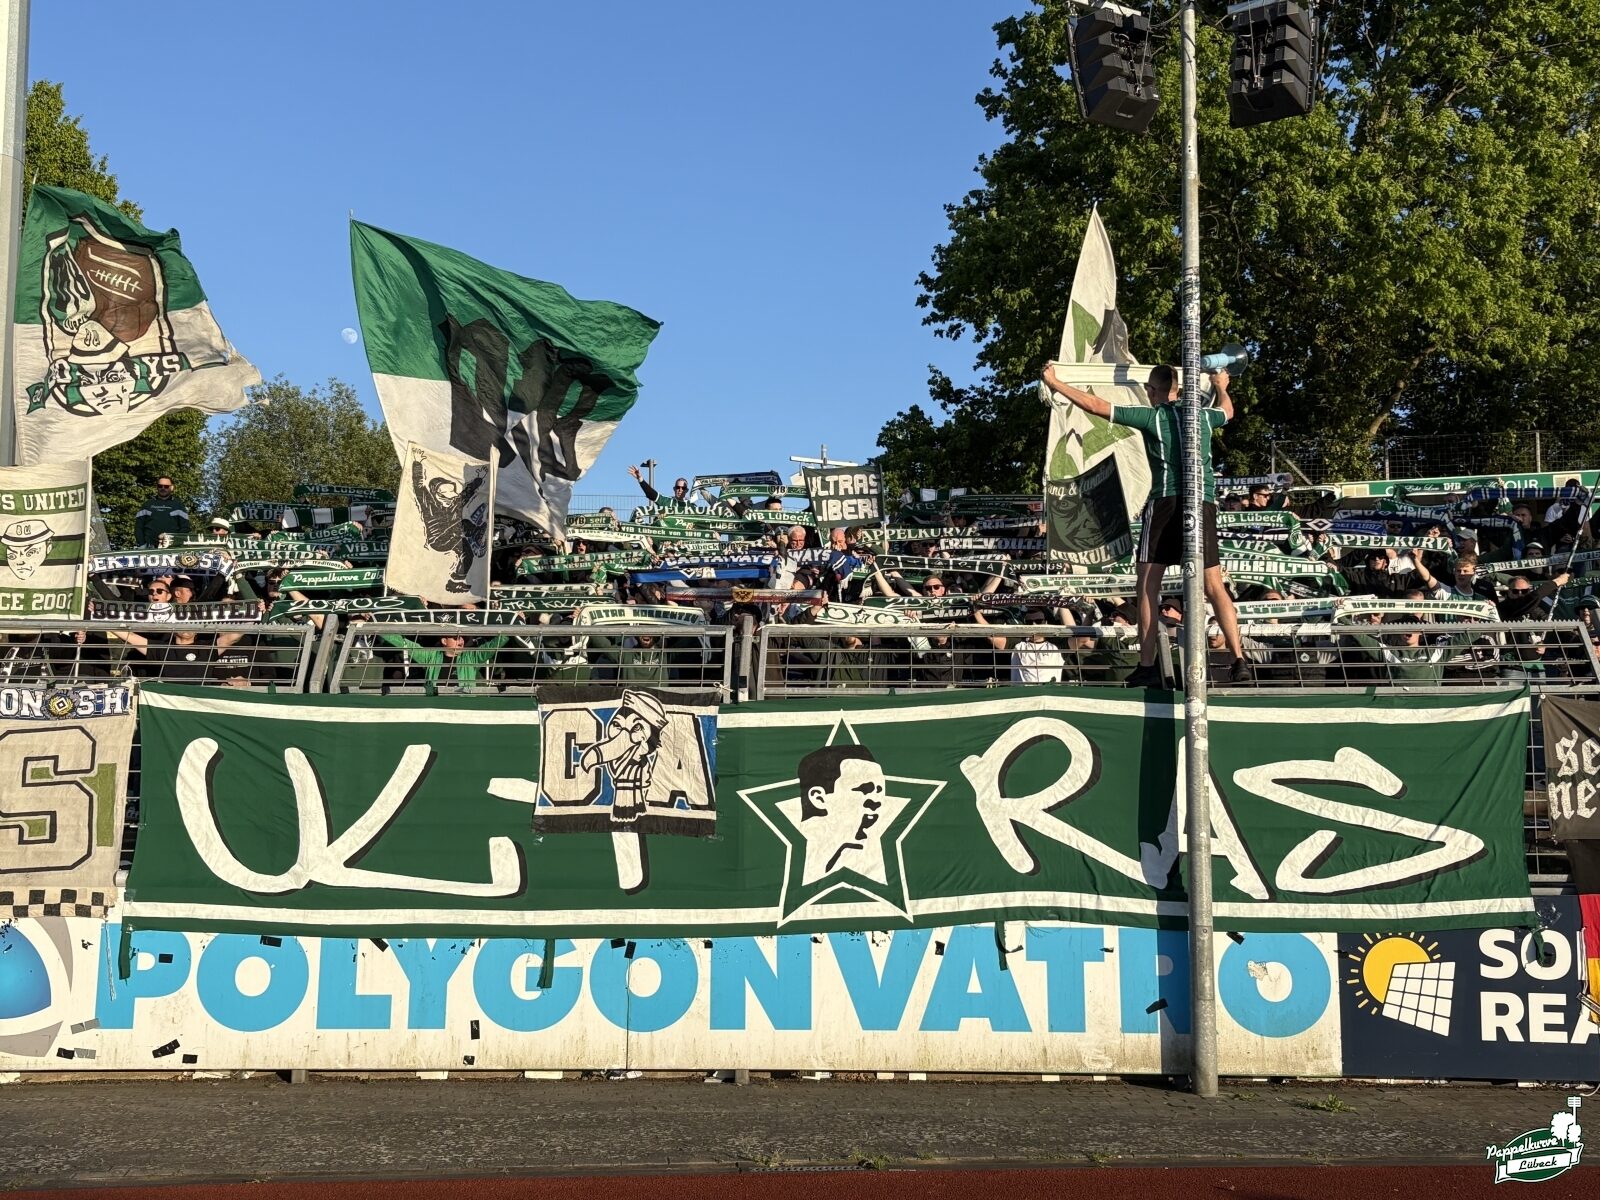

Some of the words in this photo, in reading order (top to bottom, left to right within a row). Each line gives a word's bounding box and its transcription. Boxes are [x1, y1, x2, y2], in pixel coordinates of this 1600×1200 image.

[807, 474, 879, 497] ULTRAS
[1233, 476, 1274, 485] VEREIN
[307, 485, 329, 493] VfB
[334, 486, 377, 496] Lübeck
[23, 487, 86, 511] UNITED
[263, 509, 283, 520] DE
[746, 512, 765, 521] VfB
[769, 511, 811, 522] Lübeck
[1216, 514, 1236, 523] VfB
[1240, 513, 1285, 523] Lübeck
[309, 525, 351, 540] Lübeck
[620, 525, 635, 533] VfB
[638, 527, 666, 535] Lübeck
[227, 537, 259, 550] NUR
[1329, 534, 1450, 547] APPELKURV
[345, 543, 369, 552] VfB
[292, 573, 359, 586] Pappelkurve
[93, 602, 149, 621] BOYS
[174, 601, 261, 621] UNITED
[97, 921, 1331, 1037] POLYGONVATRO
